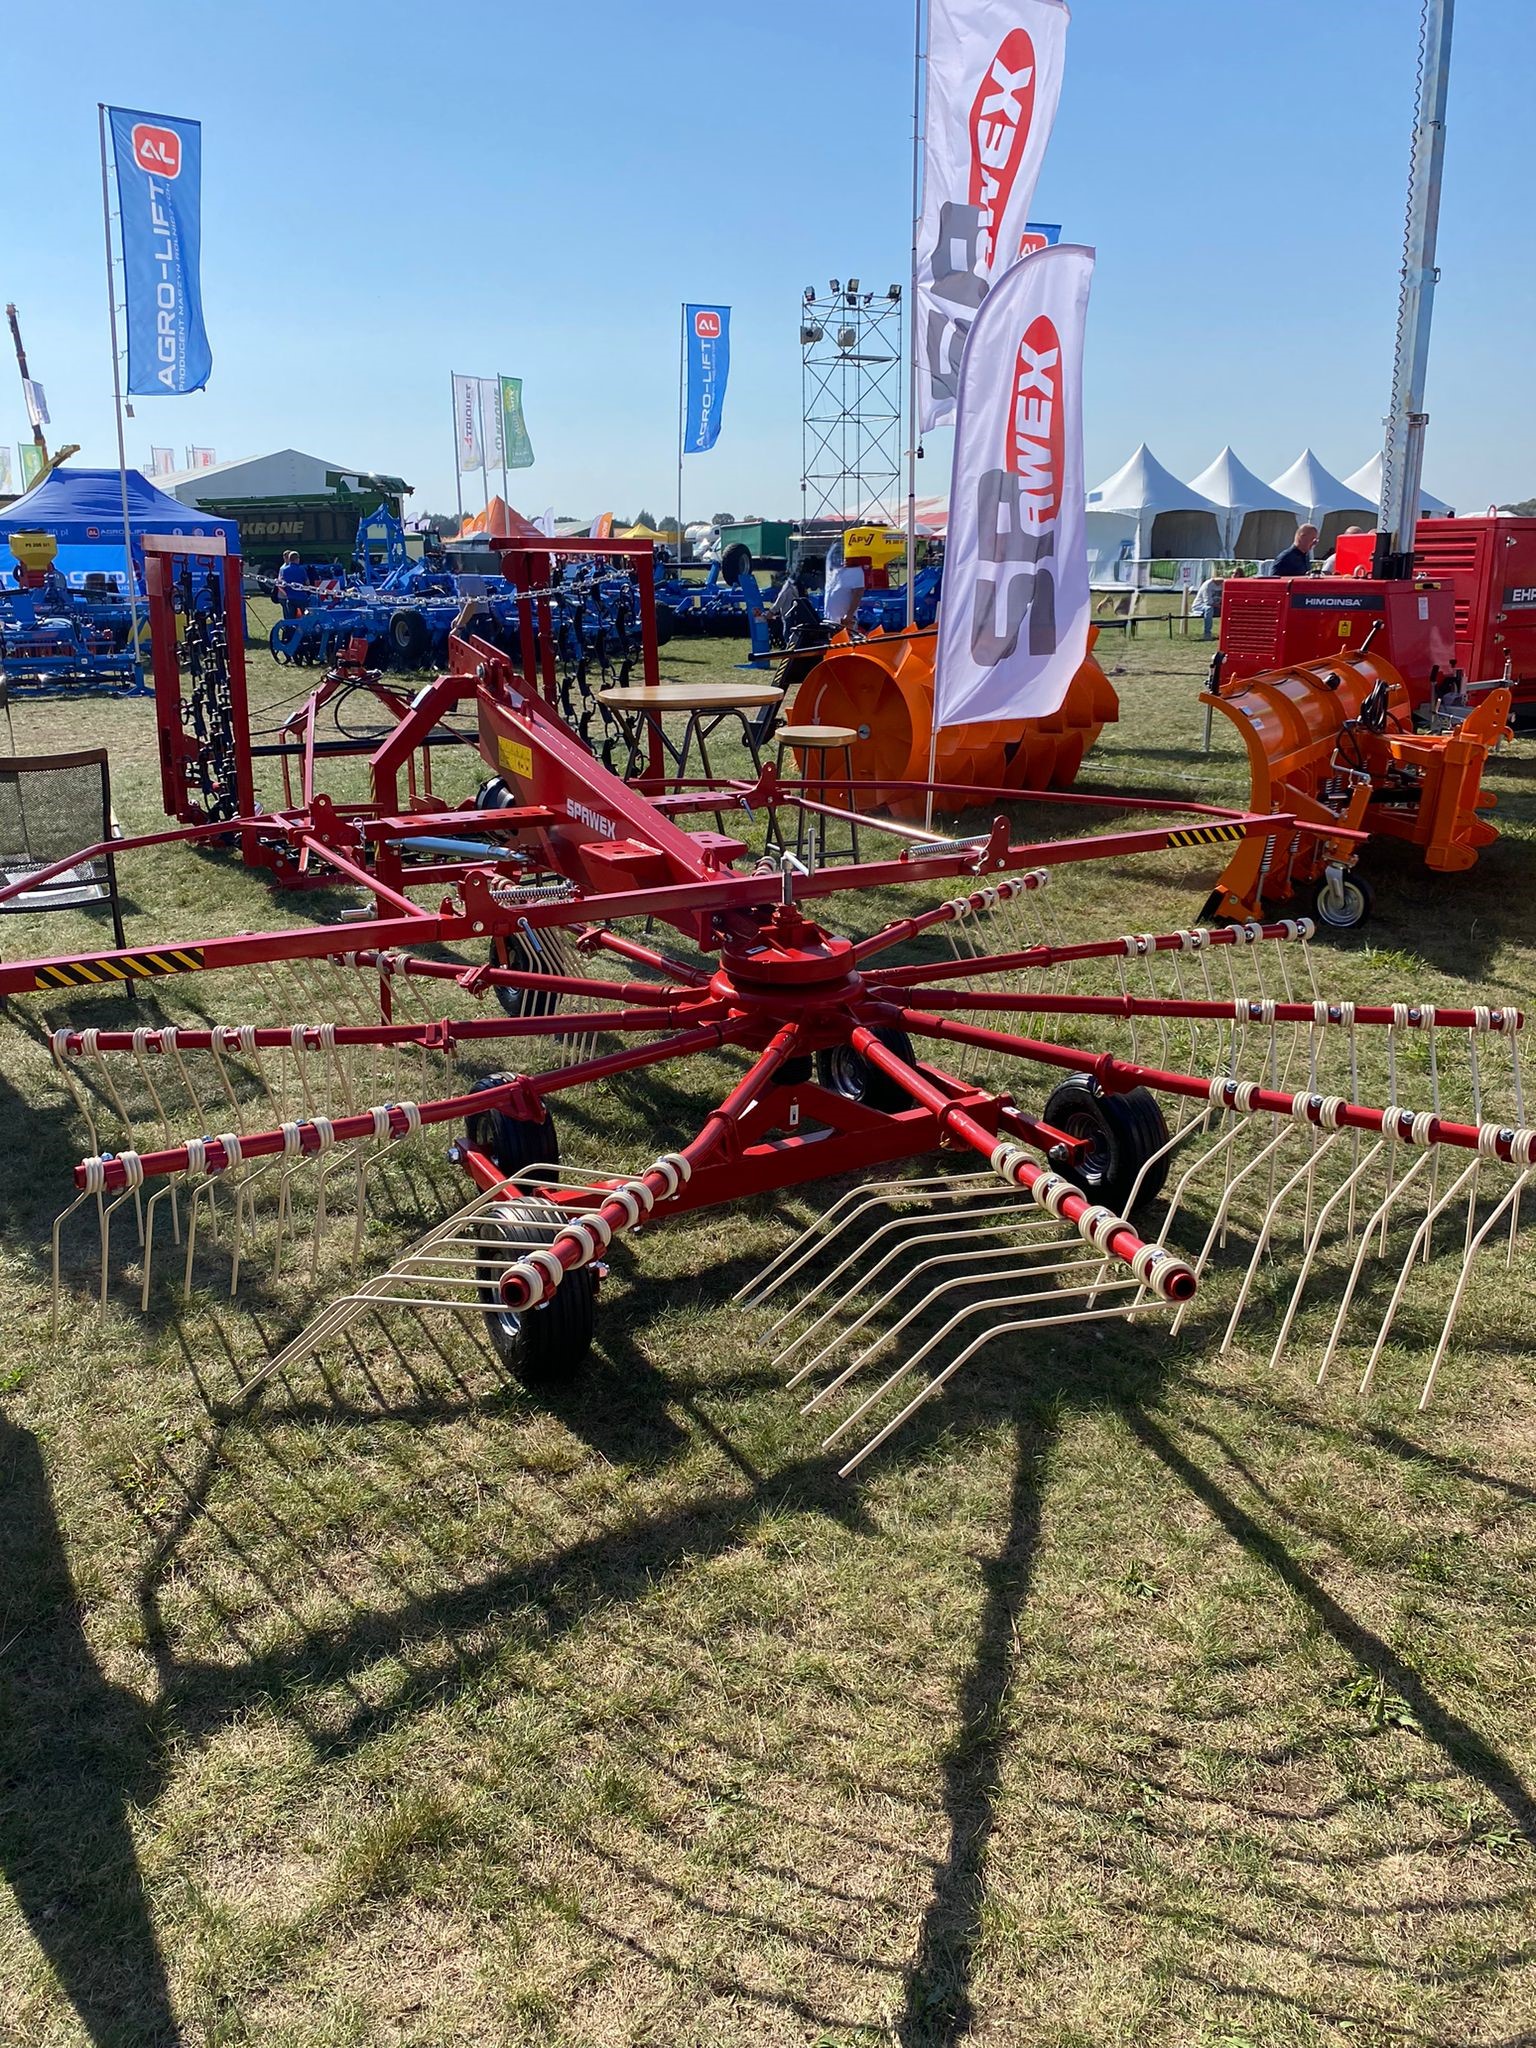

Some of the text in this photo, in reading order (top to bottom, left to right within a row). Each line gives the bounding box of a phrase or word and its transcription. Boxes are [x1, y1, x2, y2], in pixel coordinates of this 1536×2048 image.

[140, 139, 175, 164] AL
[148, 175, 177, 391] AGRO-LIFT
[699, 319, 718, 330] AL
[178, 319, 186, 391] PRODUCENT
[696, 339, 712, 446] AGRO-LIFT
[970, 342, 1061, 666] SPAWEX
[242, 521, 305, 535] KRONE
[1305, 598, 1361, 606] HIMOINSA
[566, 798, 616, 840] SPAWEX
